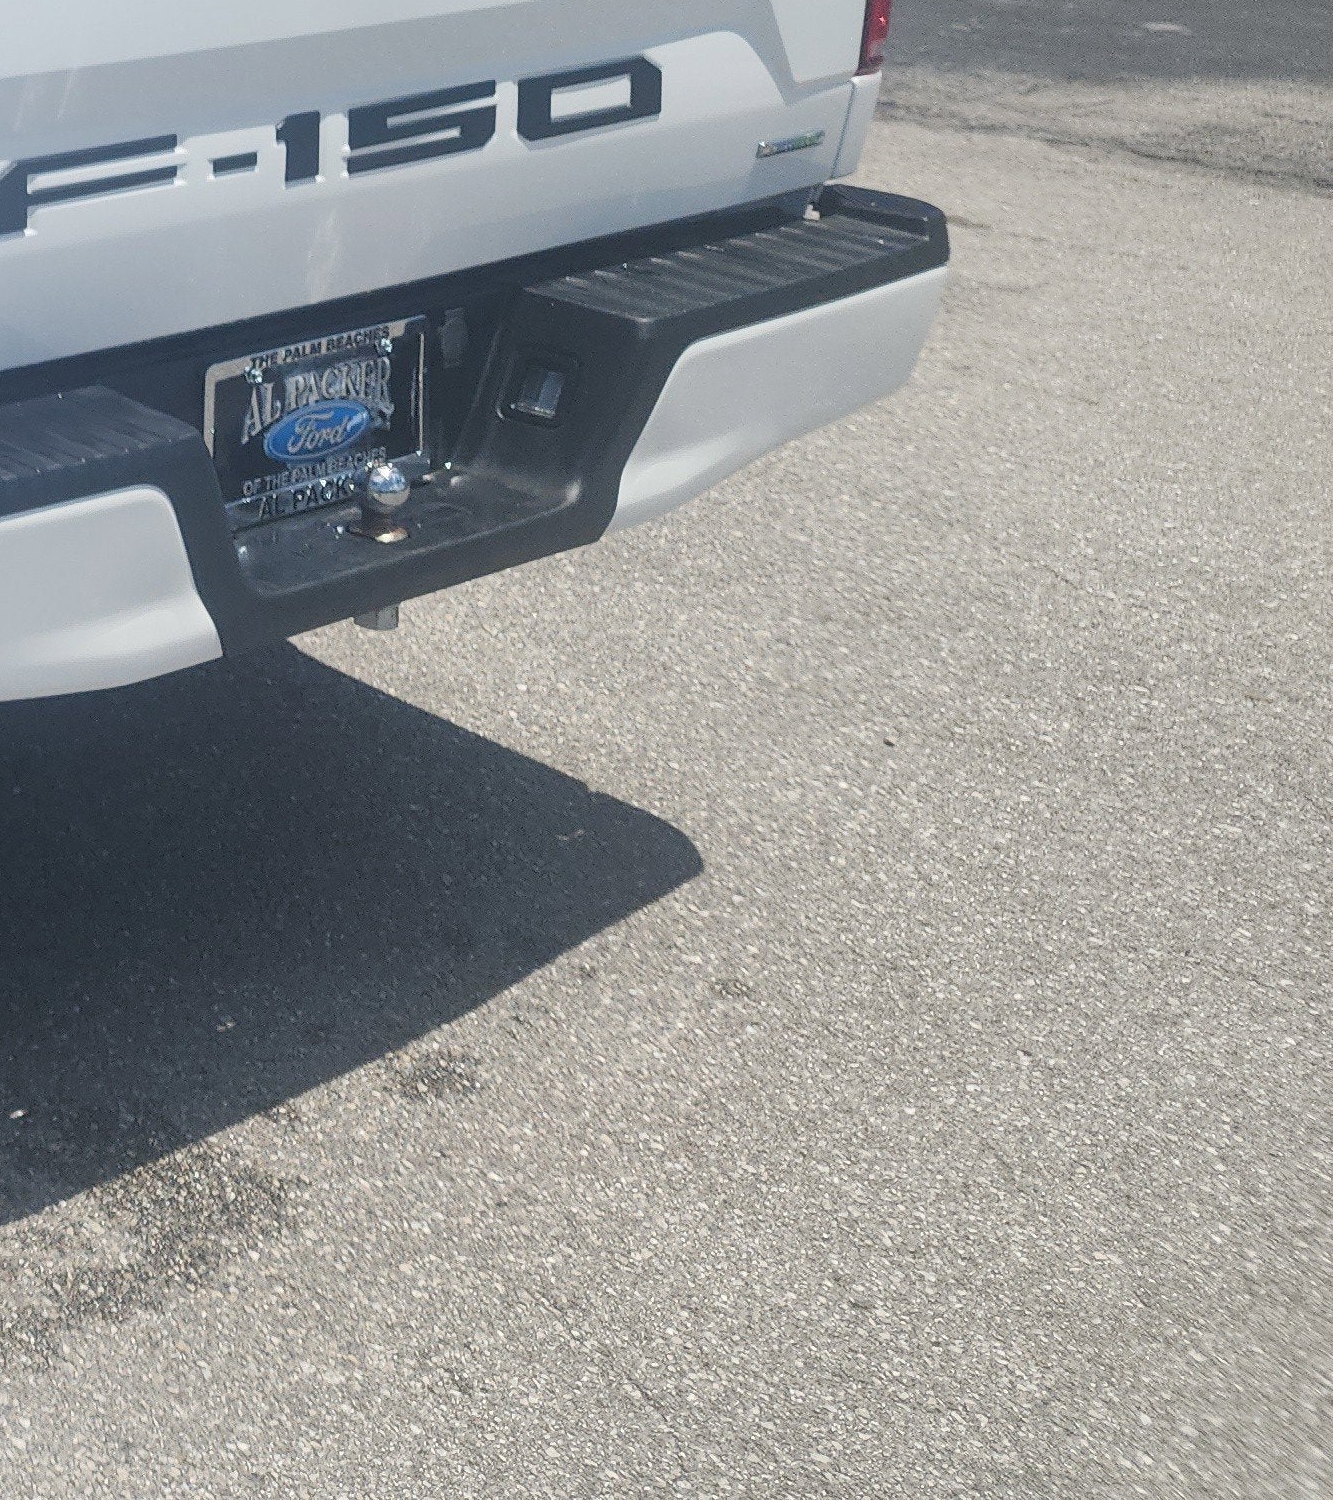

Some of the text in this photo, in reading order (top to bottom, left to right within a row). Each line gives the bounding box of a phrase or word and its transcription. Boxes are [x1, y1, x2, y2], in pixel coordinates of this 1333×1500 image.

[249, 326, 391, 368] THE PALM BEACHES
[241, 357, 395, 445] AL PACKER
[288, 411, 358, 453] Ford
[242, 478, 261, 496] OF
[265, 471, 290, 490] THE
